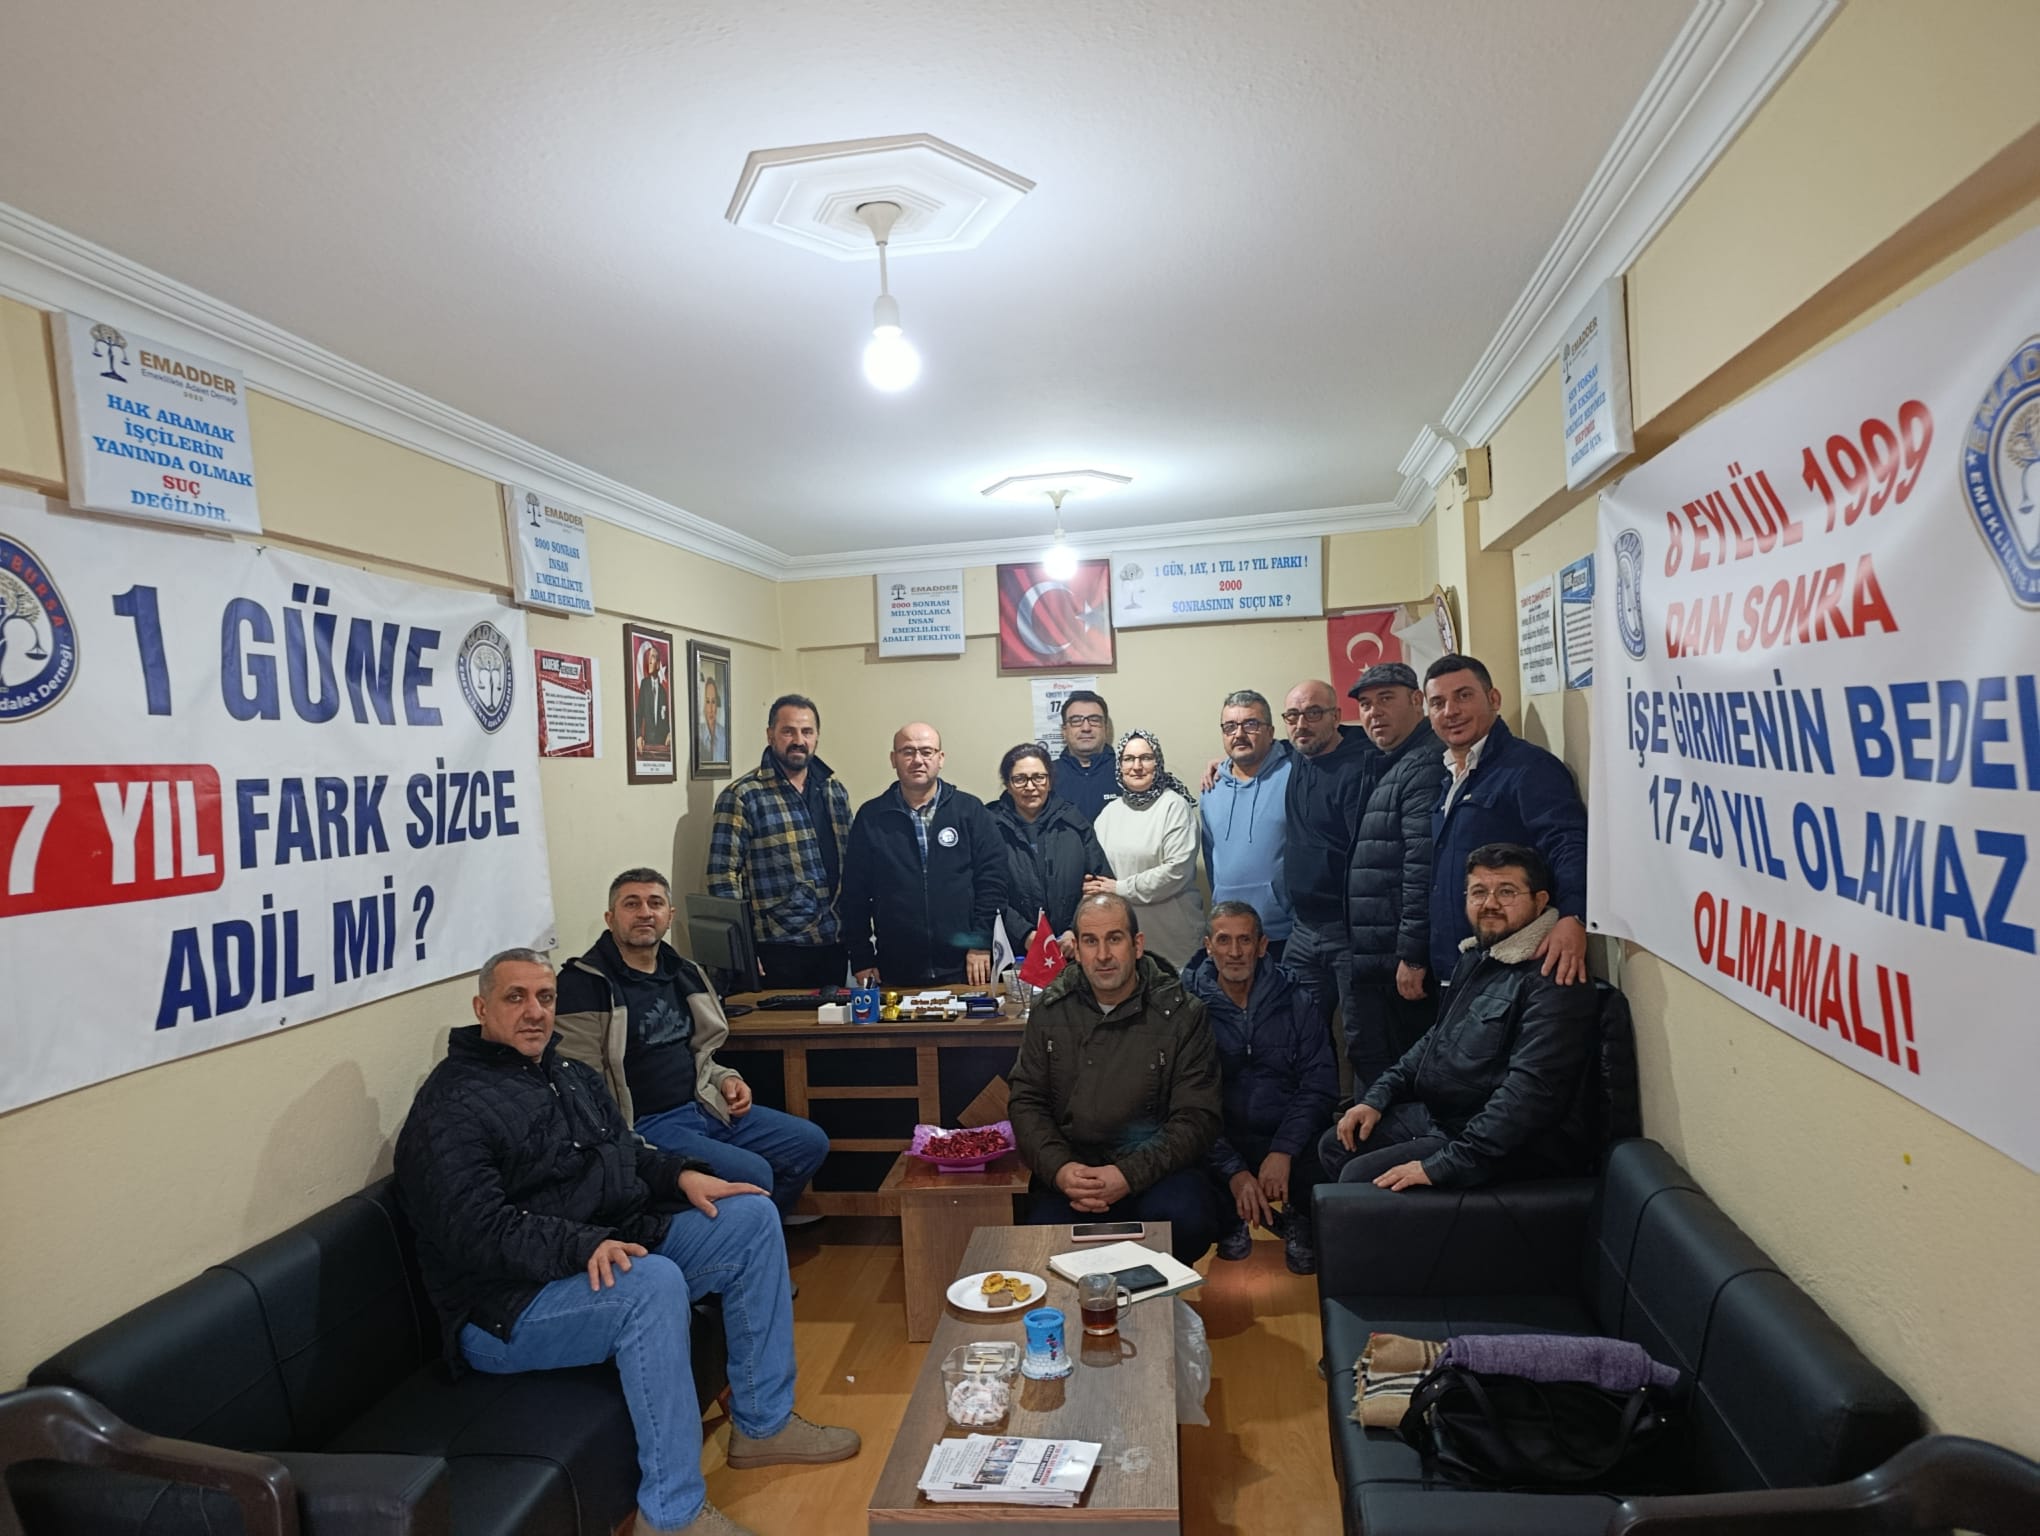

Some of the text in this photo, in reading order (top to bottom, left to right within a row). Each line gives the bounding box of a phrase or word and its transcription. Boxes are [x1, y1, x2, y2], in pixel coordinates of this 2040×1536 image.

[140, 350, 236, 394] EMADDER
[185, 382, 209, 397] Adalet
[107, 394, 236, 442] HAK ARAMAK
[124, 417, 224, 460] İŞÇİLERİN
[92, 436, 253, 487] YANINDA OLMAK
[131, 489, 231, 522] DEĞİLDİR.
[162, 475, 200, 498] SUÇ
[1664, 400, 1934, 578] 8 EYLÜL 1999
[544, 506, 584, 527] EMADDER
[1155, 566, 1160, 577] 1
[1212, 562, 1216, 574] 1
[1219, 560, 1235, 572] YIL
[1238, 560, 1250, 572] 17
[1252, 558, 1268, 570] YIL
[1271, 556, 1302, 569] FARKI
[1219, 579, 1242, 592] 2000
[10, 554, 65, 628] BURSA
[530, 588, 556, 604] ADALET
[910, 584, 958, 593] EMADDER
[912, 600, 950, 608] SONRASI
[1172, 594, 1292, 614] SONRASININ SUÇU NE ?
[1664, 590, 1734, 660] DAN
[1736, 553, 1900, 653] SONRA
[882, 635, 916, 643] ADALET
[908, 616, 934, 625] İNSAN
[37, 644, 73, 698] Derneği
[112, 582, 444, 727] 1 GÜNE
[1626, 676, 1669, 769] İŞE
[1669, 668, 1835, 776] GİRMENİN
[93, 780, 216, 886] YIL
[236, 775, 390, 870] FARK
[406, 756, 520, 850] SİZCE
[1648, 774, 2038, 956] 17-20 YIL OLAMAZ
[155, 875, 436, 1031] ADİL Mİ ?
[1694, 890, 1920, 1076] OLMAMALI!
